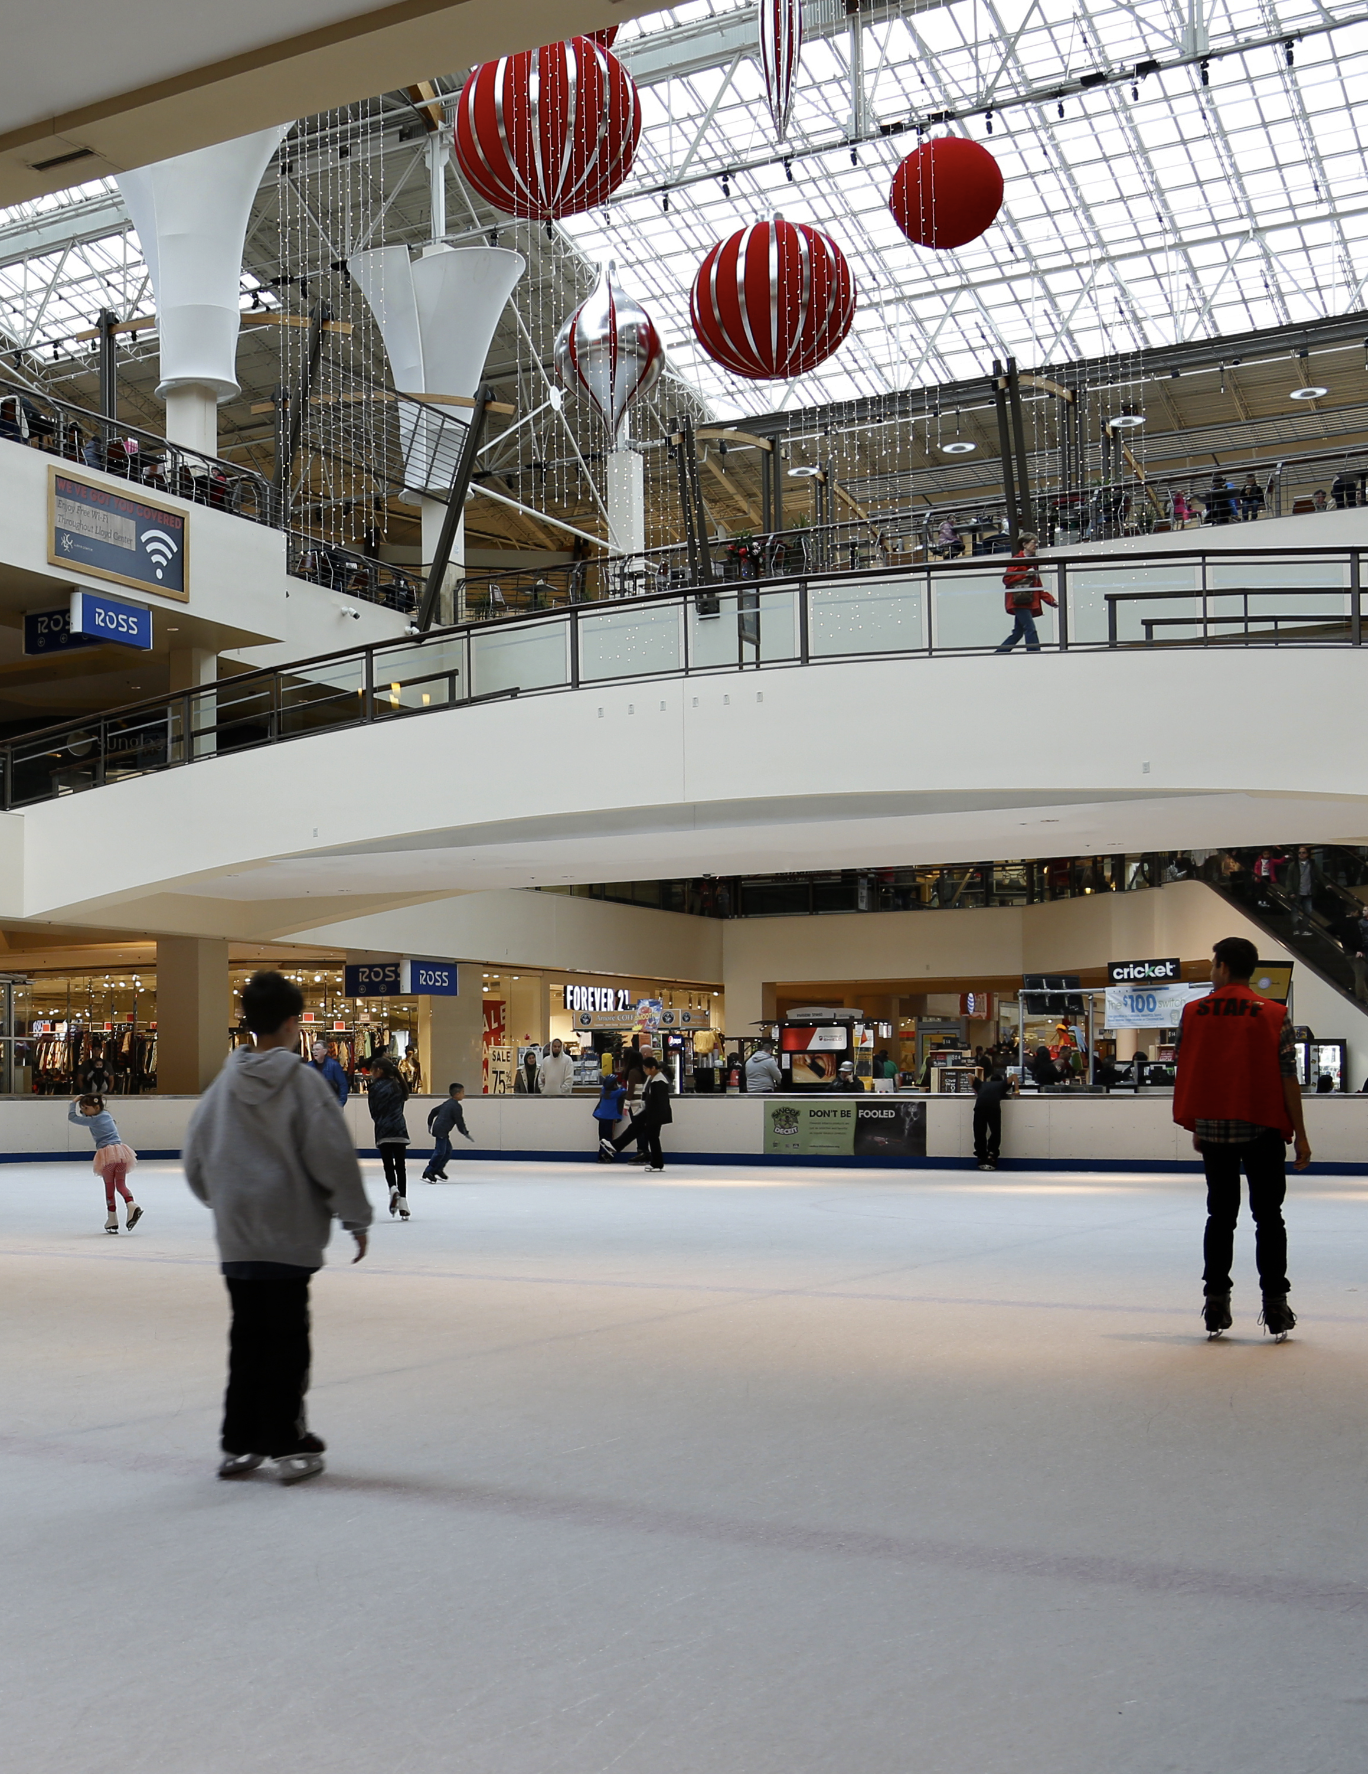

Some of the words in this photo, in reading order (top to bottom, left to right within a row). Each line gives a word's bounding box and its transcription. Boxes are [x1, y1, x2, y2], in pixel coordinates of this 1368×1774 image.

[57, 477, 87, 499] WE'VE
[90, 489, 111, 507] GOT
[112, 497, 134, 514] YOU
[136, 504, 182, 529] COVERED
[57, 499, 75, 513] Enjoy
[76, 503, 91, 517] Free
[92, 508, 109, 524] Wi-Fi
[57, 514, 94, 534] Throughout
[94, 525, 112, 540] Lloyd
[113, 531, 134, 546] Center
[95, 607, 138, 635] ROSS
[419, 969, 449, 987] ROSS
[1112, 961, 1174, 980] cricket
[566, 984, 614, 1012] FOREVER
[617, 989, 630, 1011] 21
[1107, 999, 1122, 1010] The
[1123, 993, 1157, 1013] $100
[1158, 997, 1186, 1008] switch
[1196, 997, 1265, 1017] STAFF
[482, 1004, 507, 1034] ALE
[492, 1050, 511, 1062] SALE
[809, 1109, 838, 1118] DON'T
[840, 1109, 852, 1118] BE
[858, 1109, 896, 1118] FOOLED
